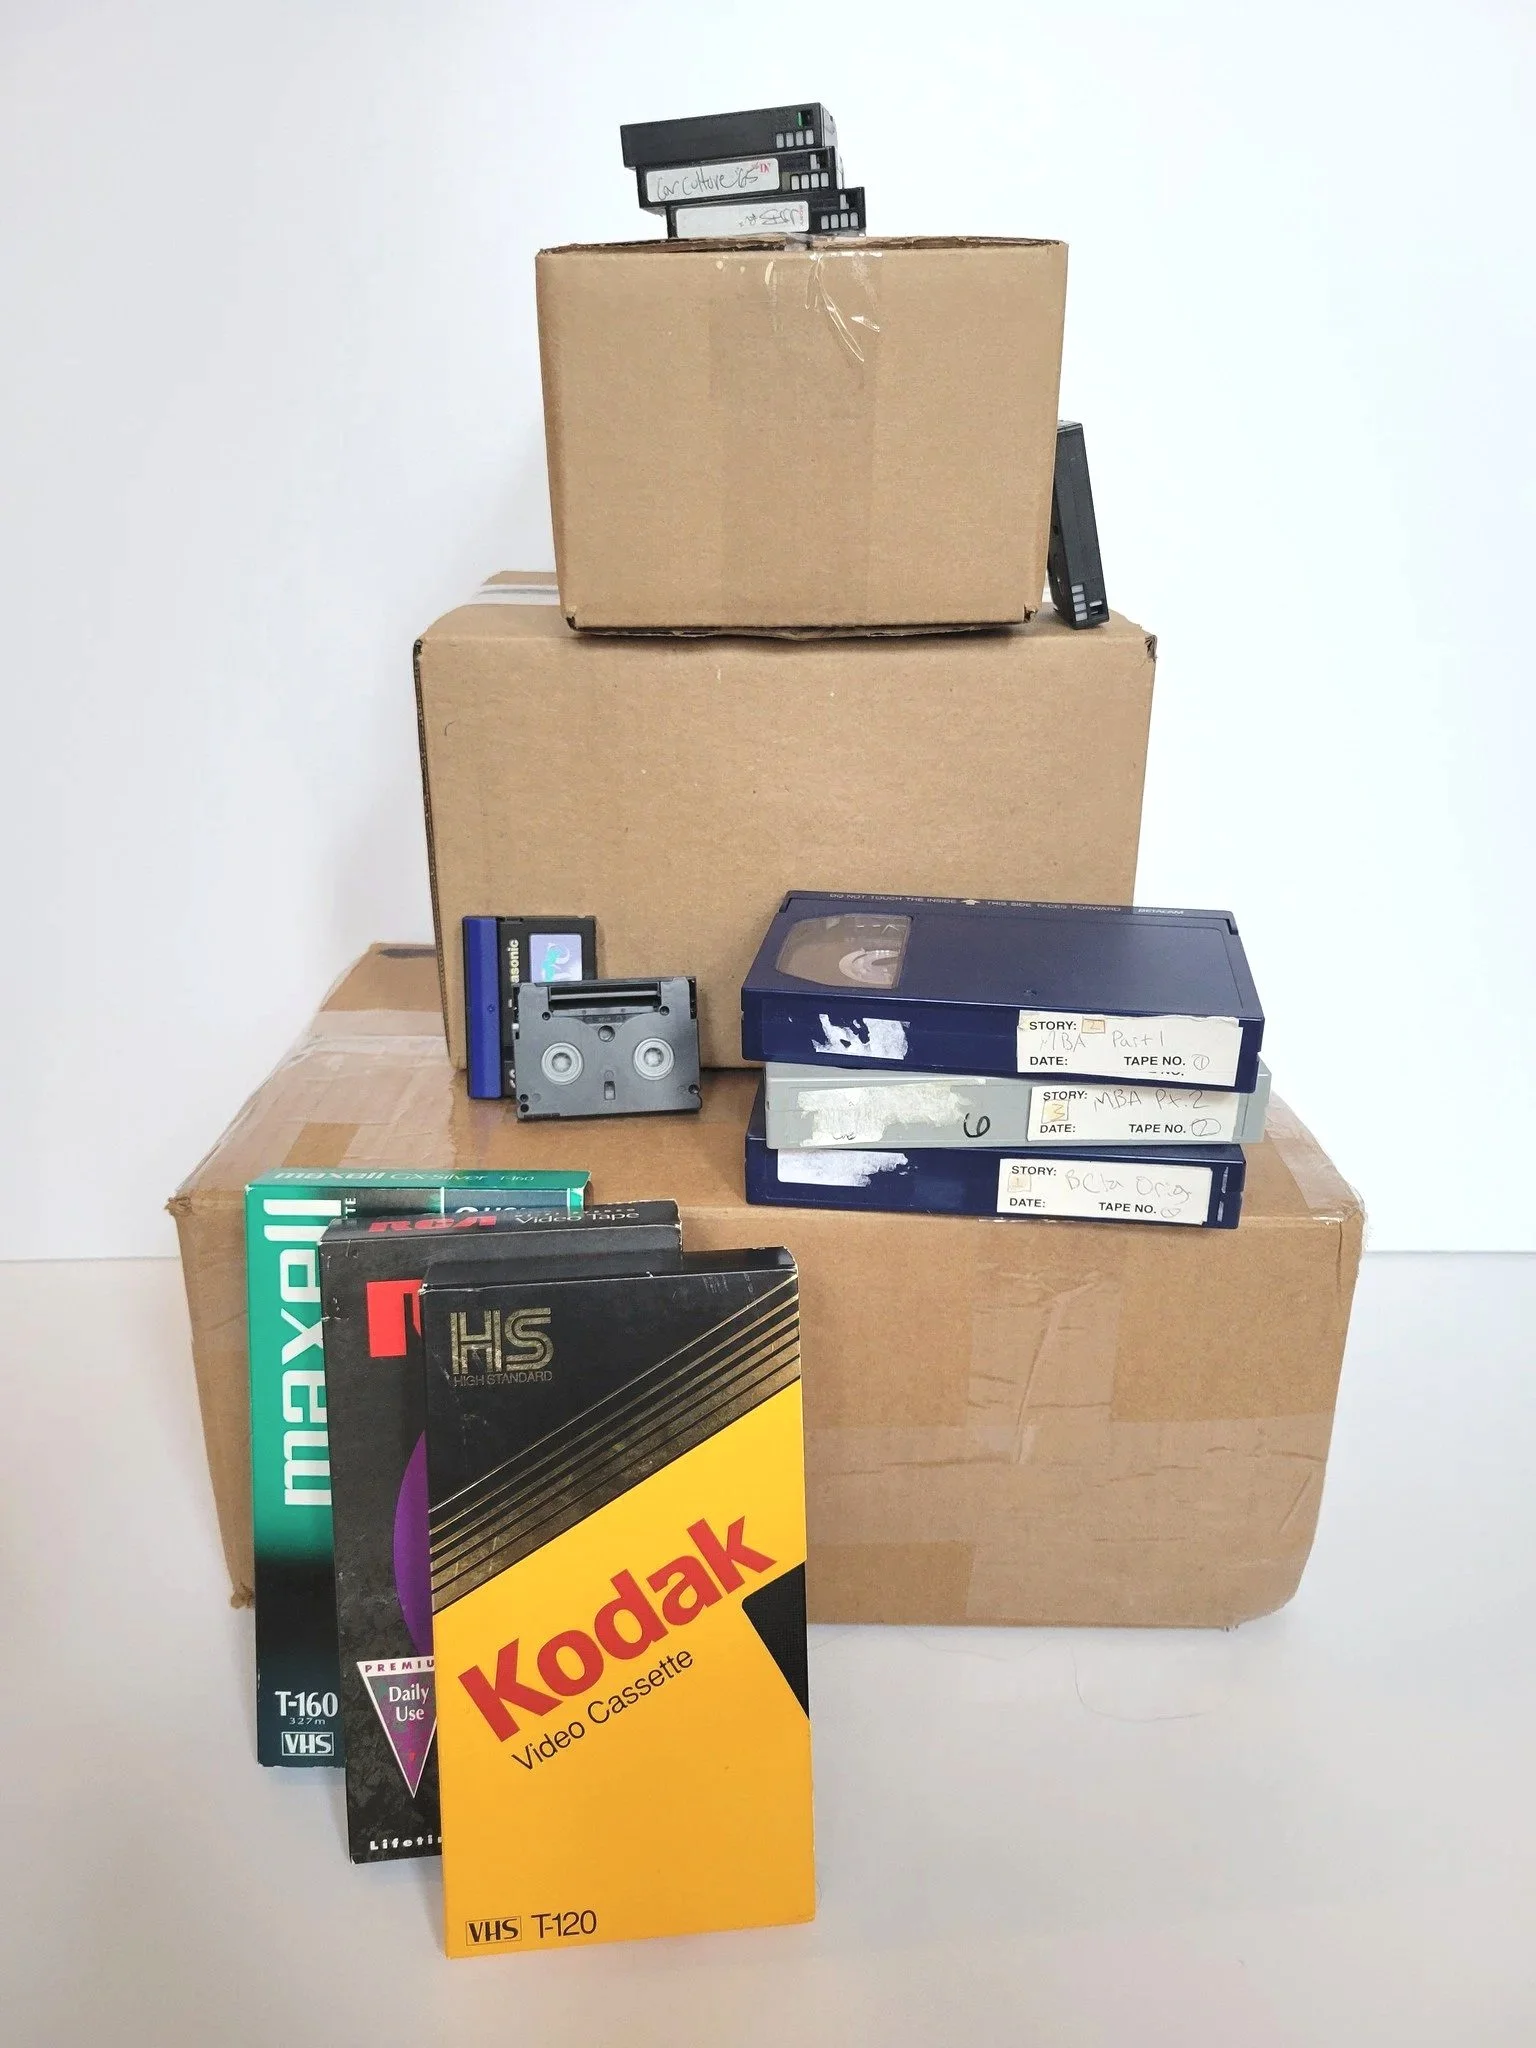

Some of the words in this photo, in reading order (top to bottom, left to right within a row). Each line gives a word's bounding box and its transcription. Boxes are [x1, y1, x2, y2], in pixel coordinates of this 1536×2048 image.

[1071, 904, 1122, 912] FORWARD
[507, 938, 520, 984] asonic
[1029, 1020, 1077, 1031] STORY:
[1029, 1056, 1068, 1066] DATE:
[1124, 1056, 1158, 1066] TAPE
[1162, 1056, 1186, 1066] NO.
[1043, 1090, 1088, 1101] STORY:
[1093, 1088, 1142, 1112] MBA
[1052, 1103, 1066, 1121] 3
[963, 1112, 991, 1139] 6
[1039, 1124, 1076, 1134] DATE:
[1129, 1124, 1161, 1134] TAPE
[1164, 1124, 1186, 1134] NO.
[273, 1172, 386, 1180] maxell
[1011, 1165, 1057, 1176] STORY:
[1009, 1198, 1046, 1208] DATE:
[1099, 1202, 1131, 1213] TAPE
[1134, 1204, 1157, 1214] NO.
[368, 1215, 497, 1233] RCA
[515, 1214, 582, 1225] Video
[589, 1211, 640, 1222] Tape
[449, 1307, 554, 1375] HS
[263, 1198, 342, 1506] maxell
[453, 1374, 485, 1387] HIGH
[487, 1370, 553, 1385] STANDARD
[457, 1515, 778, 1743] Kodak
[364, 1659, 435, 1673] PREMIU
[388, 1683, 430, 1705] Daily
[274, 1691, 339, 1717] T-160
[511, 1720, 586, 1771] Video
[587, 1650, 694, 1724] Cassette
[288, 1717, 326, 1725] 327m
[395, 1706, 425, 1722] Use
[284, 1733, 332, 1754] VHS
[468, 1918, 519, 1943] VHS
[530, 1909, 597, 1939] T-120
